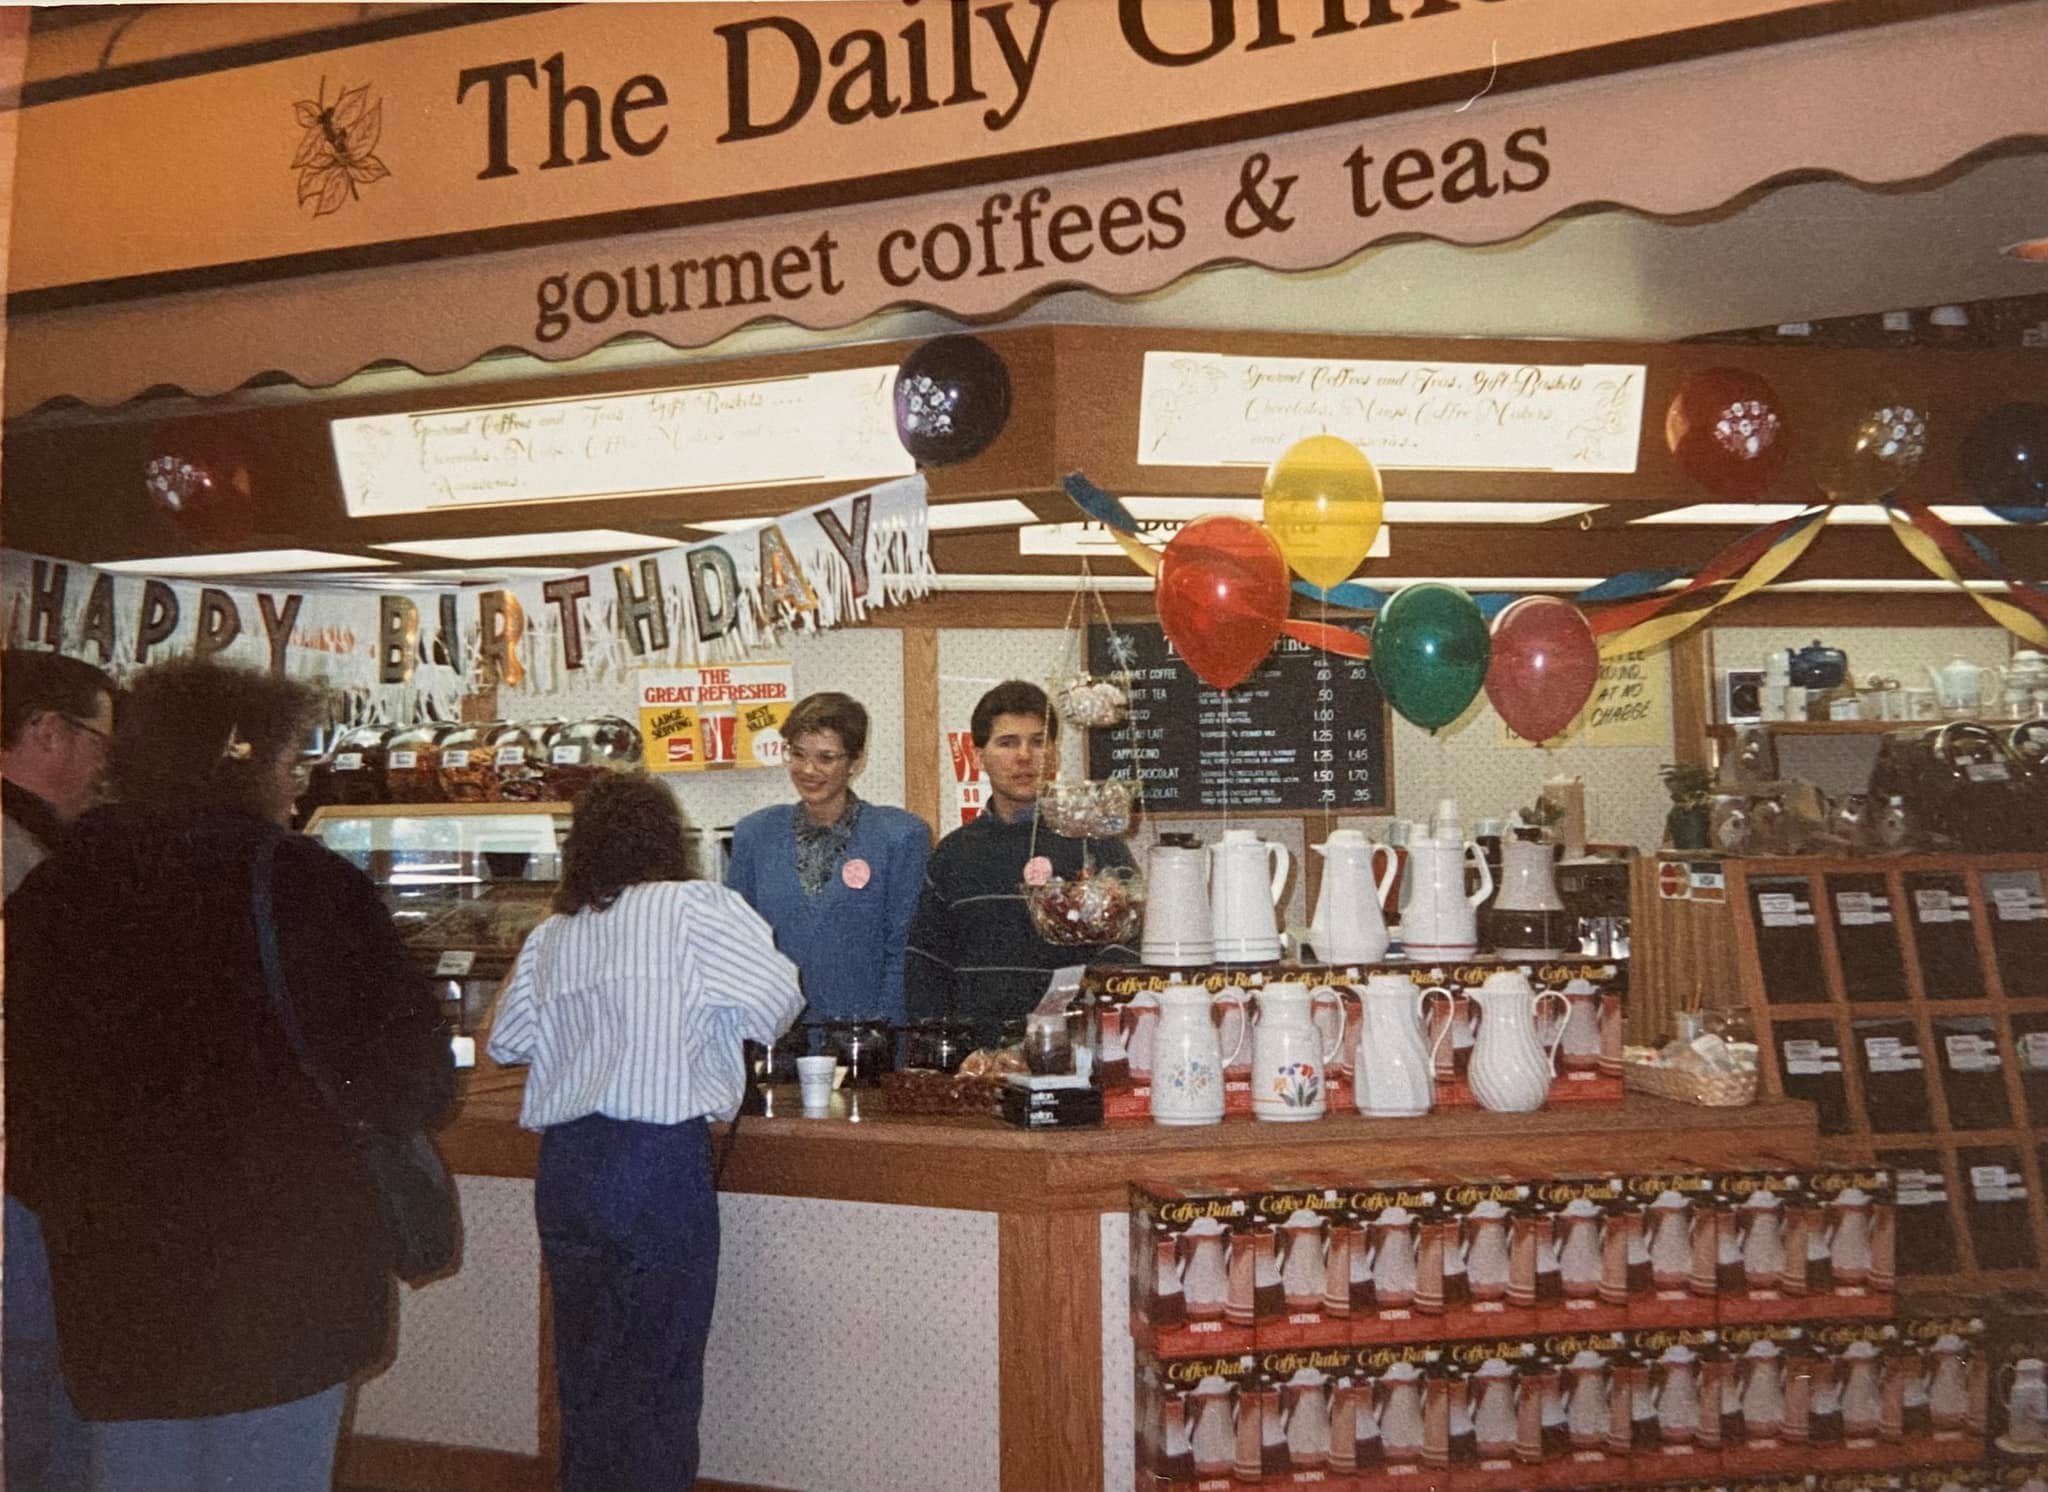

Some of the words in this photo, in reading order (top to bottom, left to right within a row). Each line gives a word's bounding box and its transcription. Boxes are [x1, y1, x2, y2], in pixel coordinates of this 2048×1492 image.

[457, 52, 669, 181] The
[714, 0, 1058, 133] Daily
[533, 229, 845, 344] gourmet
[876, 184, 1187, 288] coffees
[1223, 151, 1299, 240] &
[1342, 124, 1552, 220] teas
[28, 558, 304, 680] HAPPY
[379, 493, 872, 687] BIRTHDAY
[698, 669, 730, 685] THE
[1149, 667, 1177, 680] COFFEE
[644, 686, 694, 703] GREAT
[698, 682, 787, 703] REFRESHER
[1151, 688, 1168, 701] TEA
[1598, 686, 1617, 701] AT
[1591, 700, 1652, 728] CHARGE
[1259, 1195, 1304, 1216] Coffee
[1351, 1191, 1395, 1212] Coffee
[1160, 1202, 1206, 1224] Coffee
[1168, 1361, 1213, 1382] Coffee
[1263, 1353, 1308, 1374] Coffee
[1308, 1350, 1351, 1369] Butler
